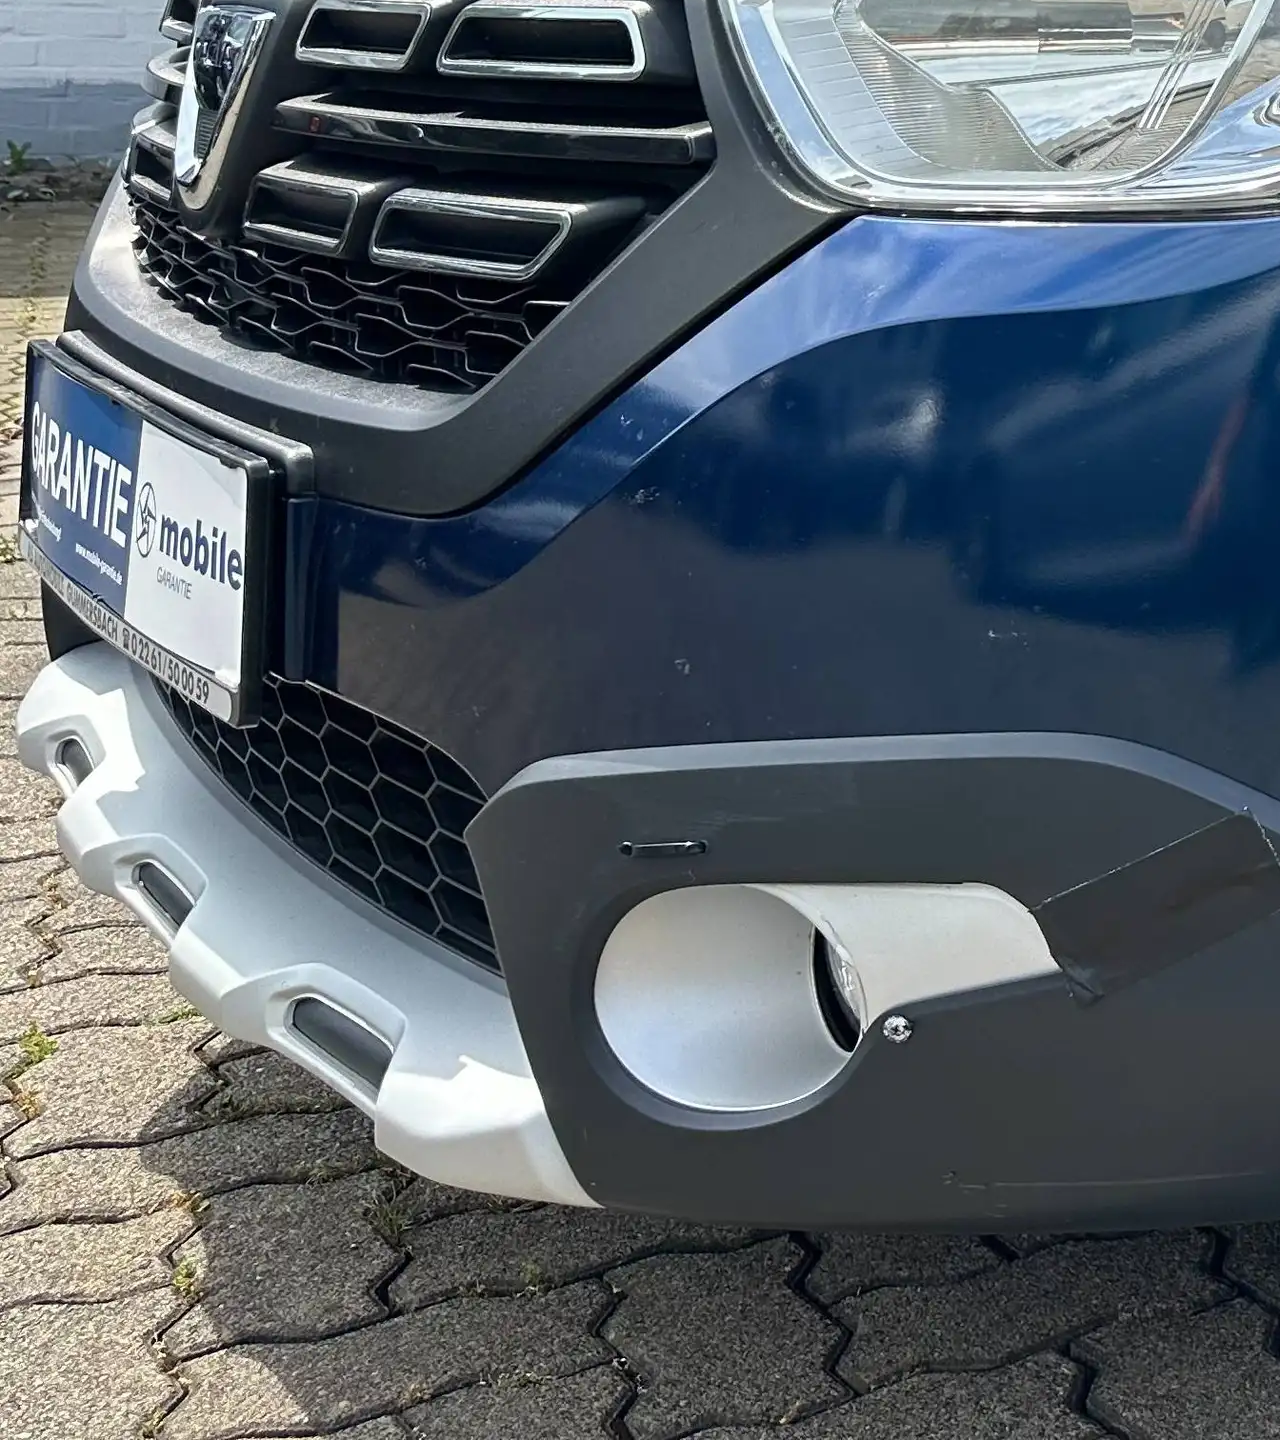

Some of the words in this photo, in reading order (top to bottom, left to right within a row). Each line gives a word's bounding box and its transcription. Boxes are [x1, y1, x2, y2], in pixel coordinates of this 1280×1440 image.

[31, 401, 132, 548] GARANTIE
[156, 566, 193, 600] GARANTIE
[159, 513, 243, 591] mobile
